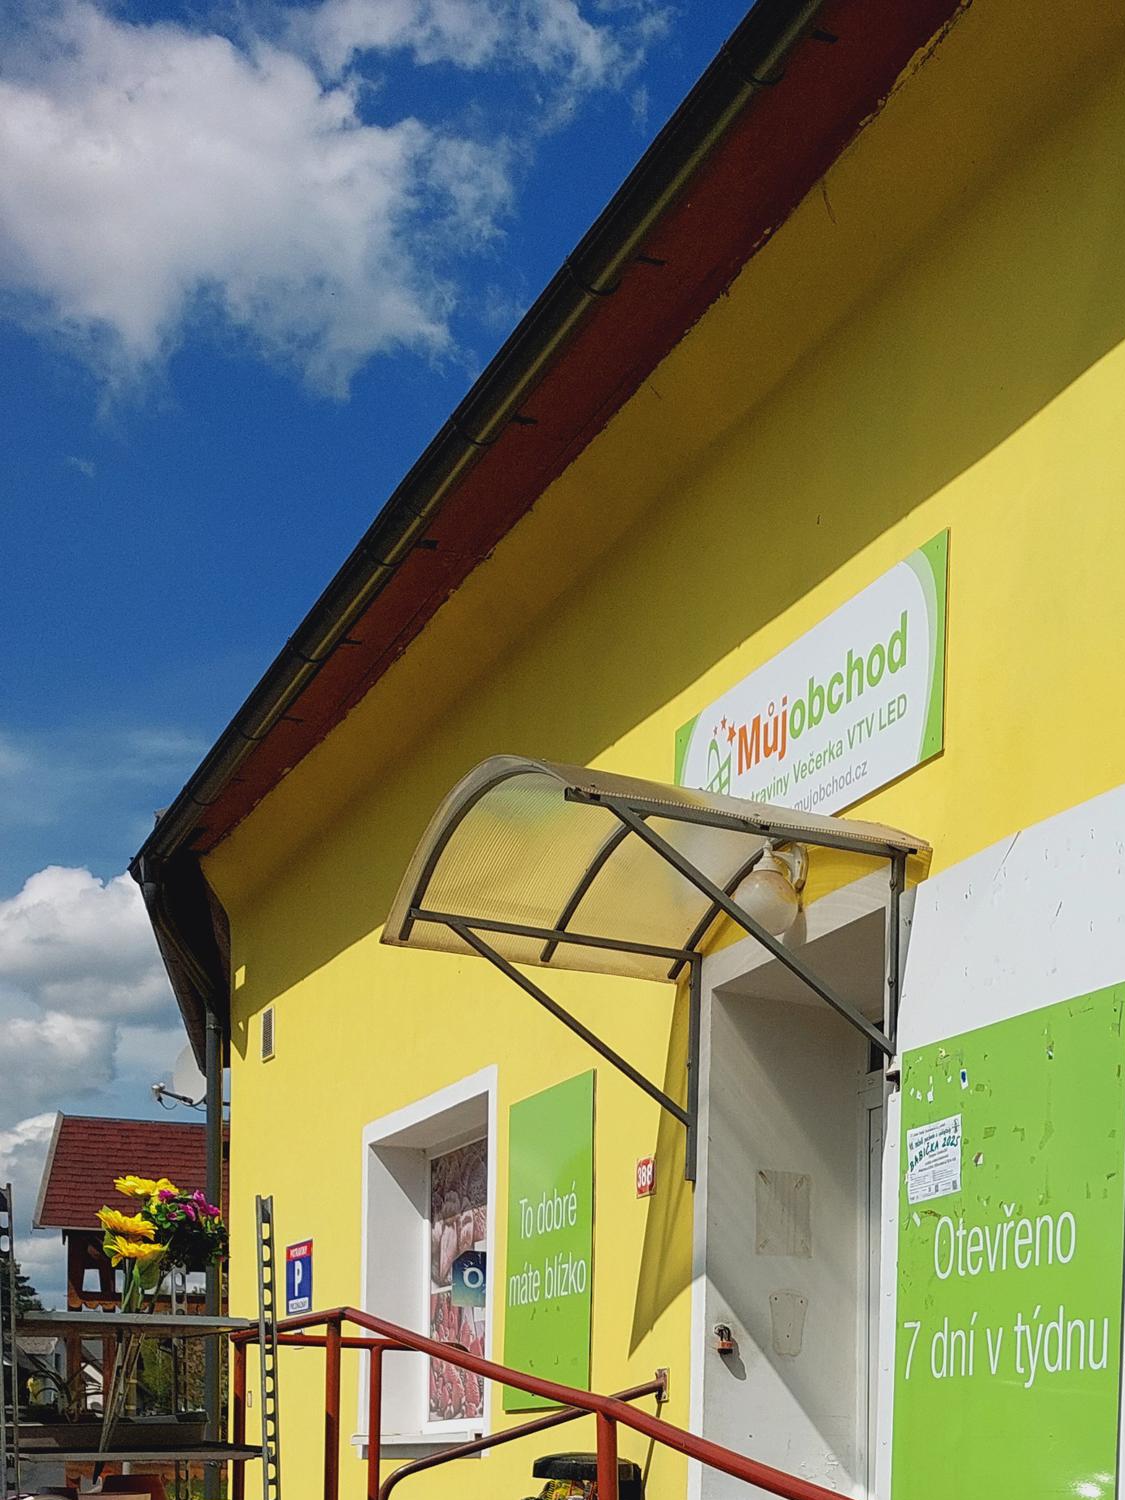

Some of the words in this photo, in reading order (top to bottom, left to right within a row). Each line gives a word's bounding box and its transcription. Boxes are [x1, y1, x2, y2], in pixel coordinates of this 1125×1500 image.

[737, 610, 908, 776] Můjobchod
[793, 738, 843, 783] Večerka
[847, 713, 875, 750] VTV
[878, 693, 907, 732] LED
[793, 760, 868, 812] mujobchod.cz
[519, 1198, 533, 1239] To
[537, 1180, 577, 1235] dobré
[934, 1202, 1076, 1280] Otevřeno
[508, 1261, 541, 1308] máte
[544, 1252, 587, 1299] blízko
[903, 1320, 921, 1380] 7
[930, 1311, 978, 1379] dní
[986, 1325, 1004, 1375] v
[1013, 1304, 1109, 1389] týdnu
